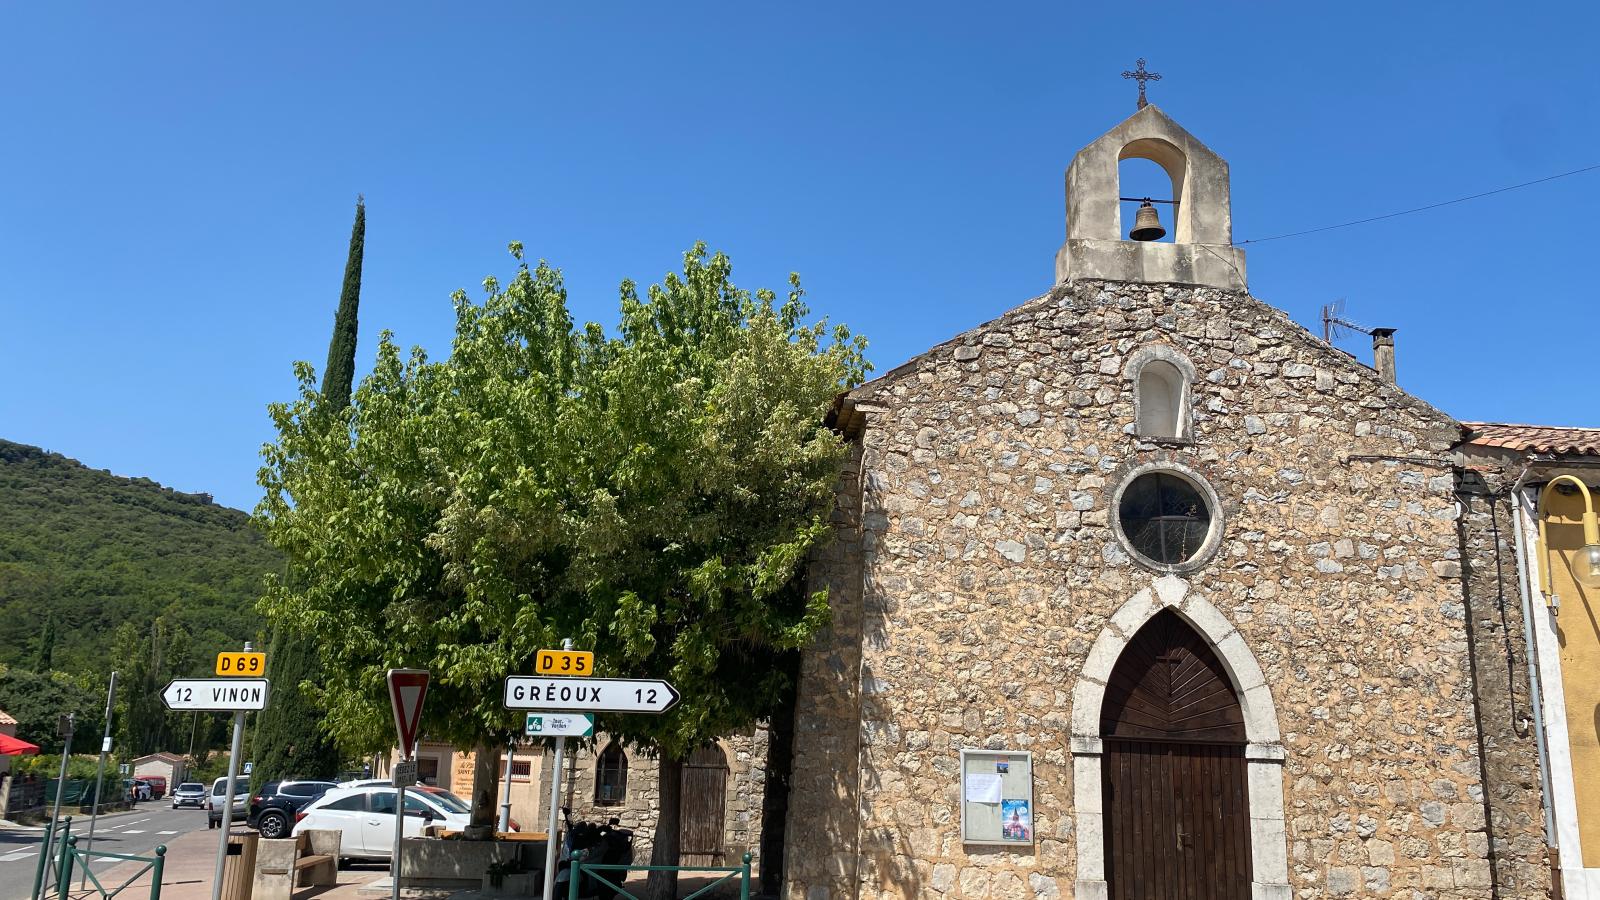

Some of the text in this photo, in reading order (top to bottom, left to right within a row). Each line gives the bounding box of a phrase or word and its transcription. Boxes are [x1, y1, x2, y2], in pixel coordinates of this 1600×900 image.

[221, 657, 259, 671] D 69
[543, 655, 585, 671] D 35
[176, 688, 260, 702] 12 VINON
[514, 683, 657, 704] GRÉOUX 12
